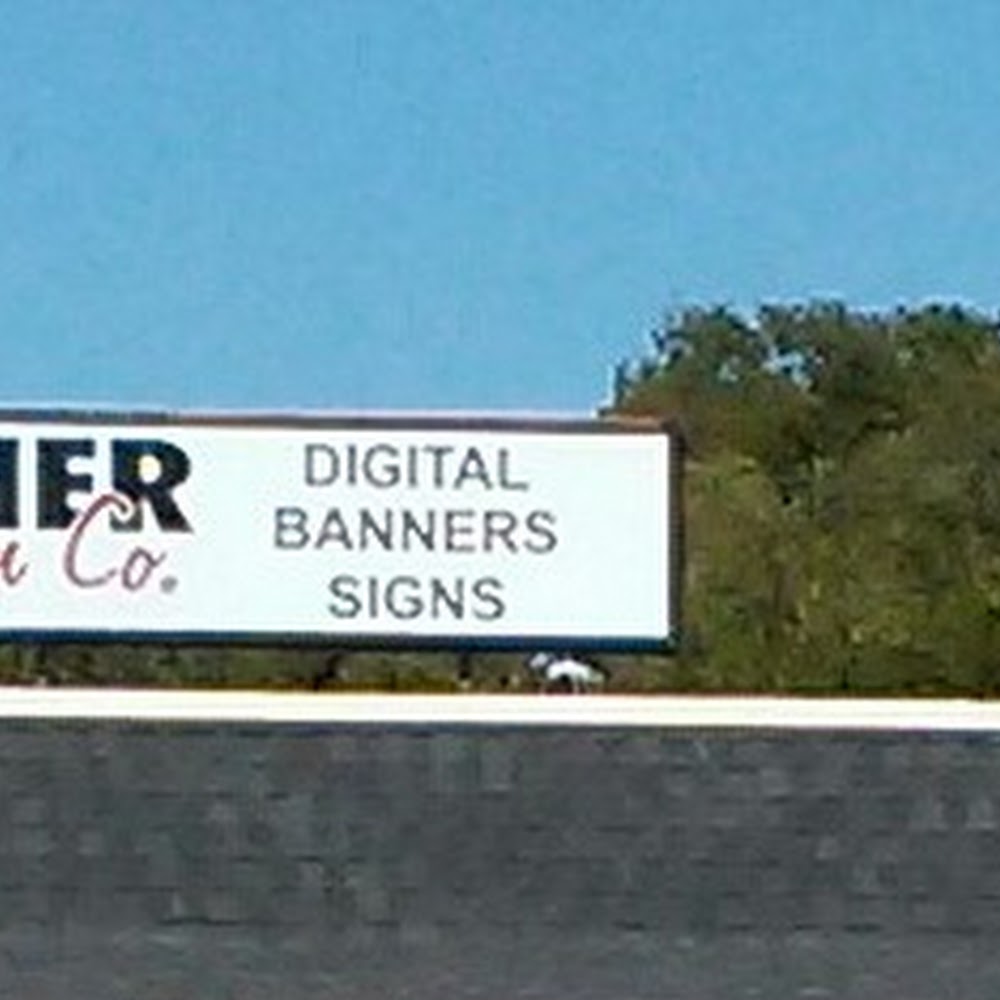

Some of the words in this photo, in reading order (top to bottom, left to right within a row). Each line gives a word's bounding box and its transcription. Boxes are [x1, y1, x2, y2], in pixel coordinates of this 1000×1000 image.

[304, 443, 530, 492] DIGITAL
[273, 505, 559, 554] BANNERS
[327, 575, 506, 621] SIGNS
